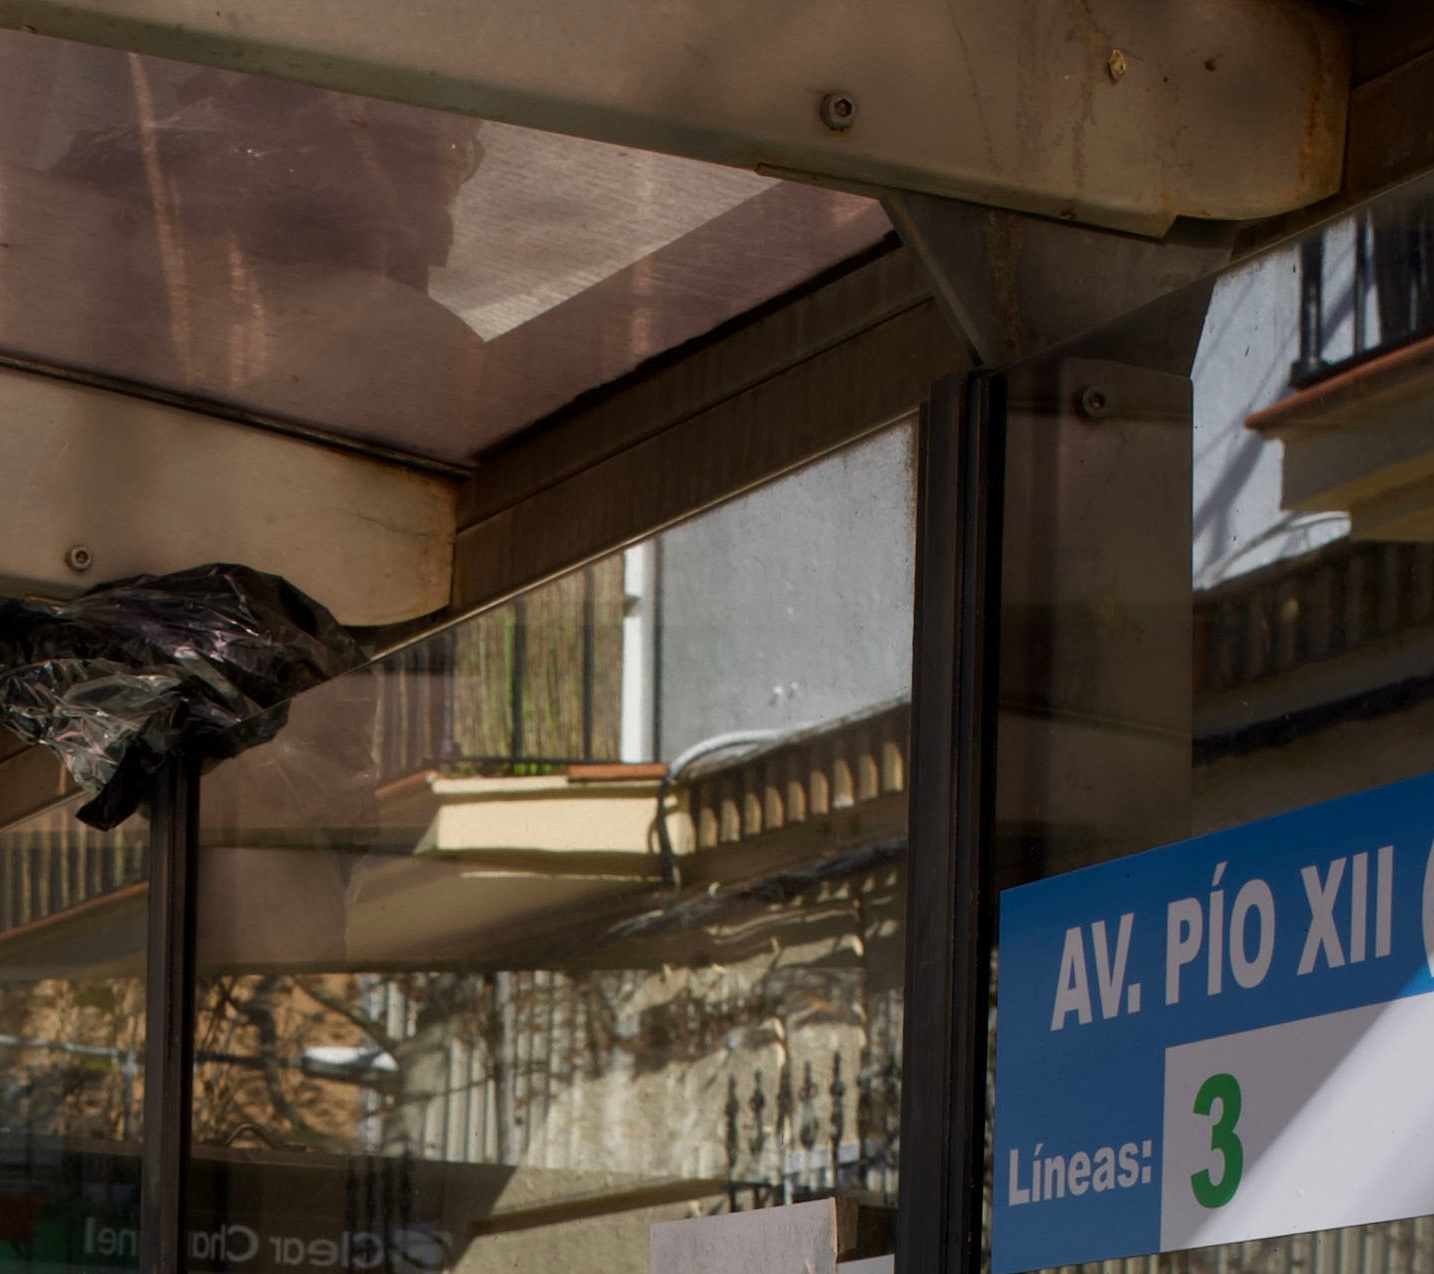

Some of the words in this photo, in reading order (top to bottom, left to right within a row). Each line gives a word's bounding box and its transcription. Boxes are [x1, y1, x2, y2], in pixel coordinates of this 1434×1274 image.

[1050, 912, 1140, 1031] AV.
[1165, 861, 1275, 1005] PÍO
[1298, 845, 1393, 975] XII
[1008, 1138, 1153, 1206] Líneas:
[1190, 1073, 1244, 1209] 3
